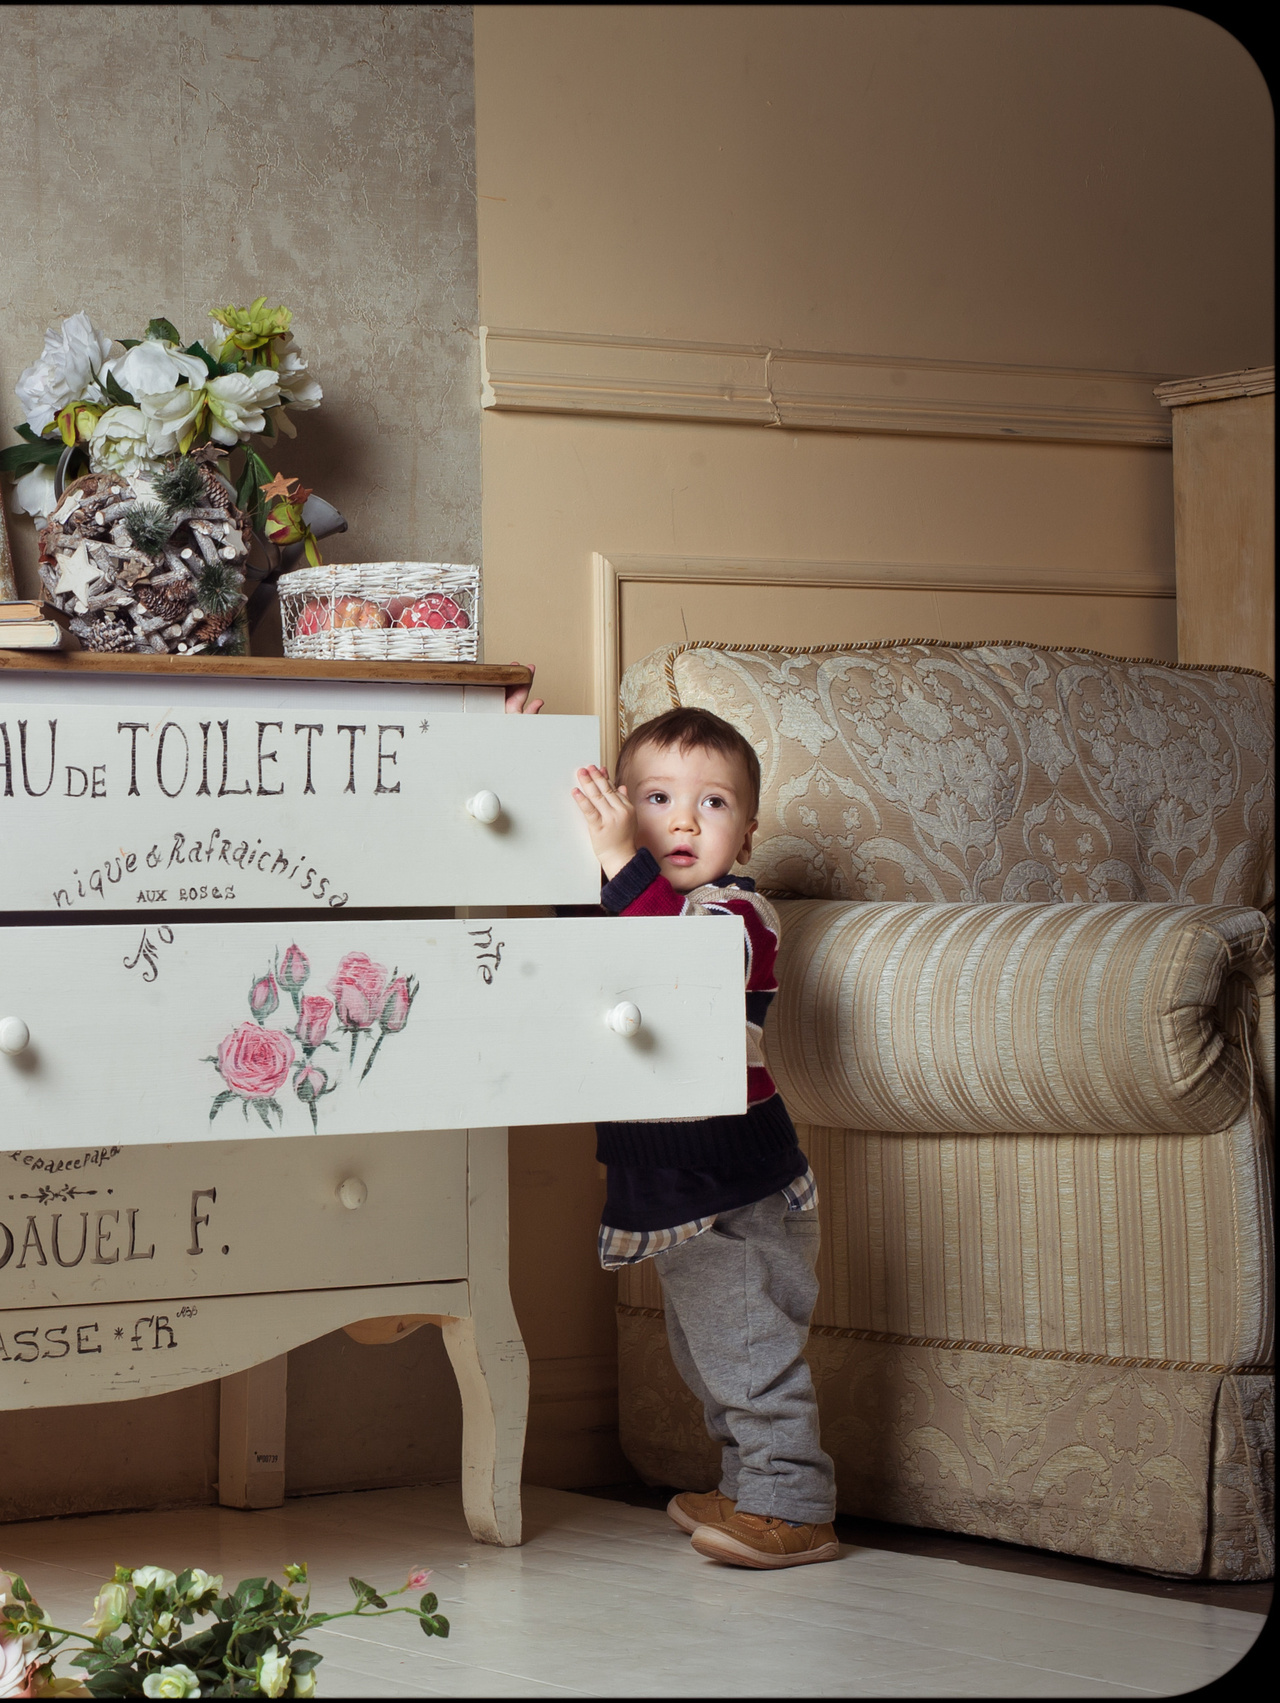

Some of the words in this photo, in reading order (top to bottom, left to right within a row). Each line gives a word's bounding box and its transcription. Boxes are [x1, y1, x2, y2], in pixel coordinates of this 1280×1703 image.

[63, 763, 107, 799] DE
[117, 718, 405, 799] TOILETTE
[136, 889, 168, 904] AUX
[186, 1186, 230, 1256] F.
